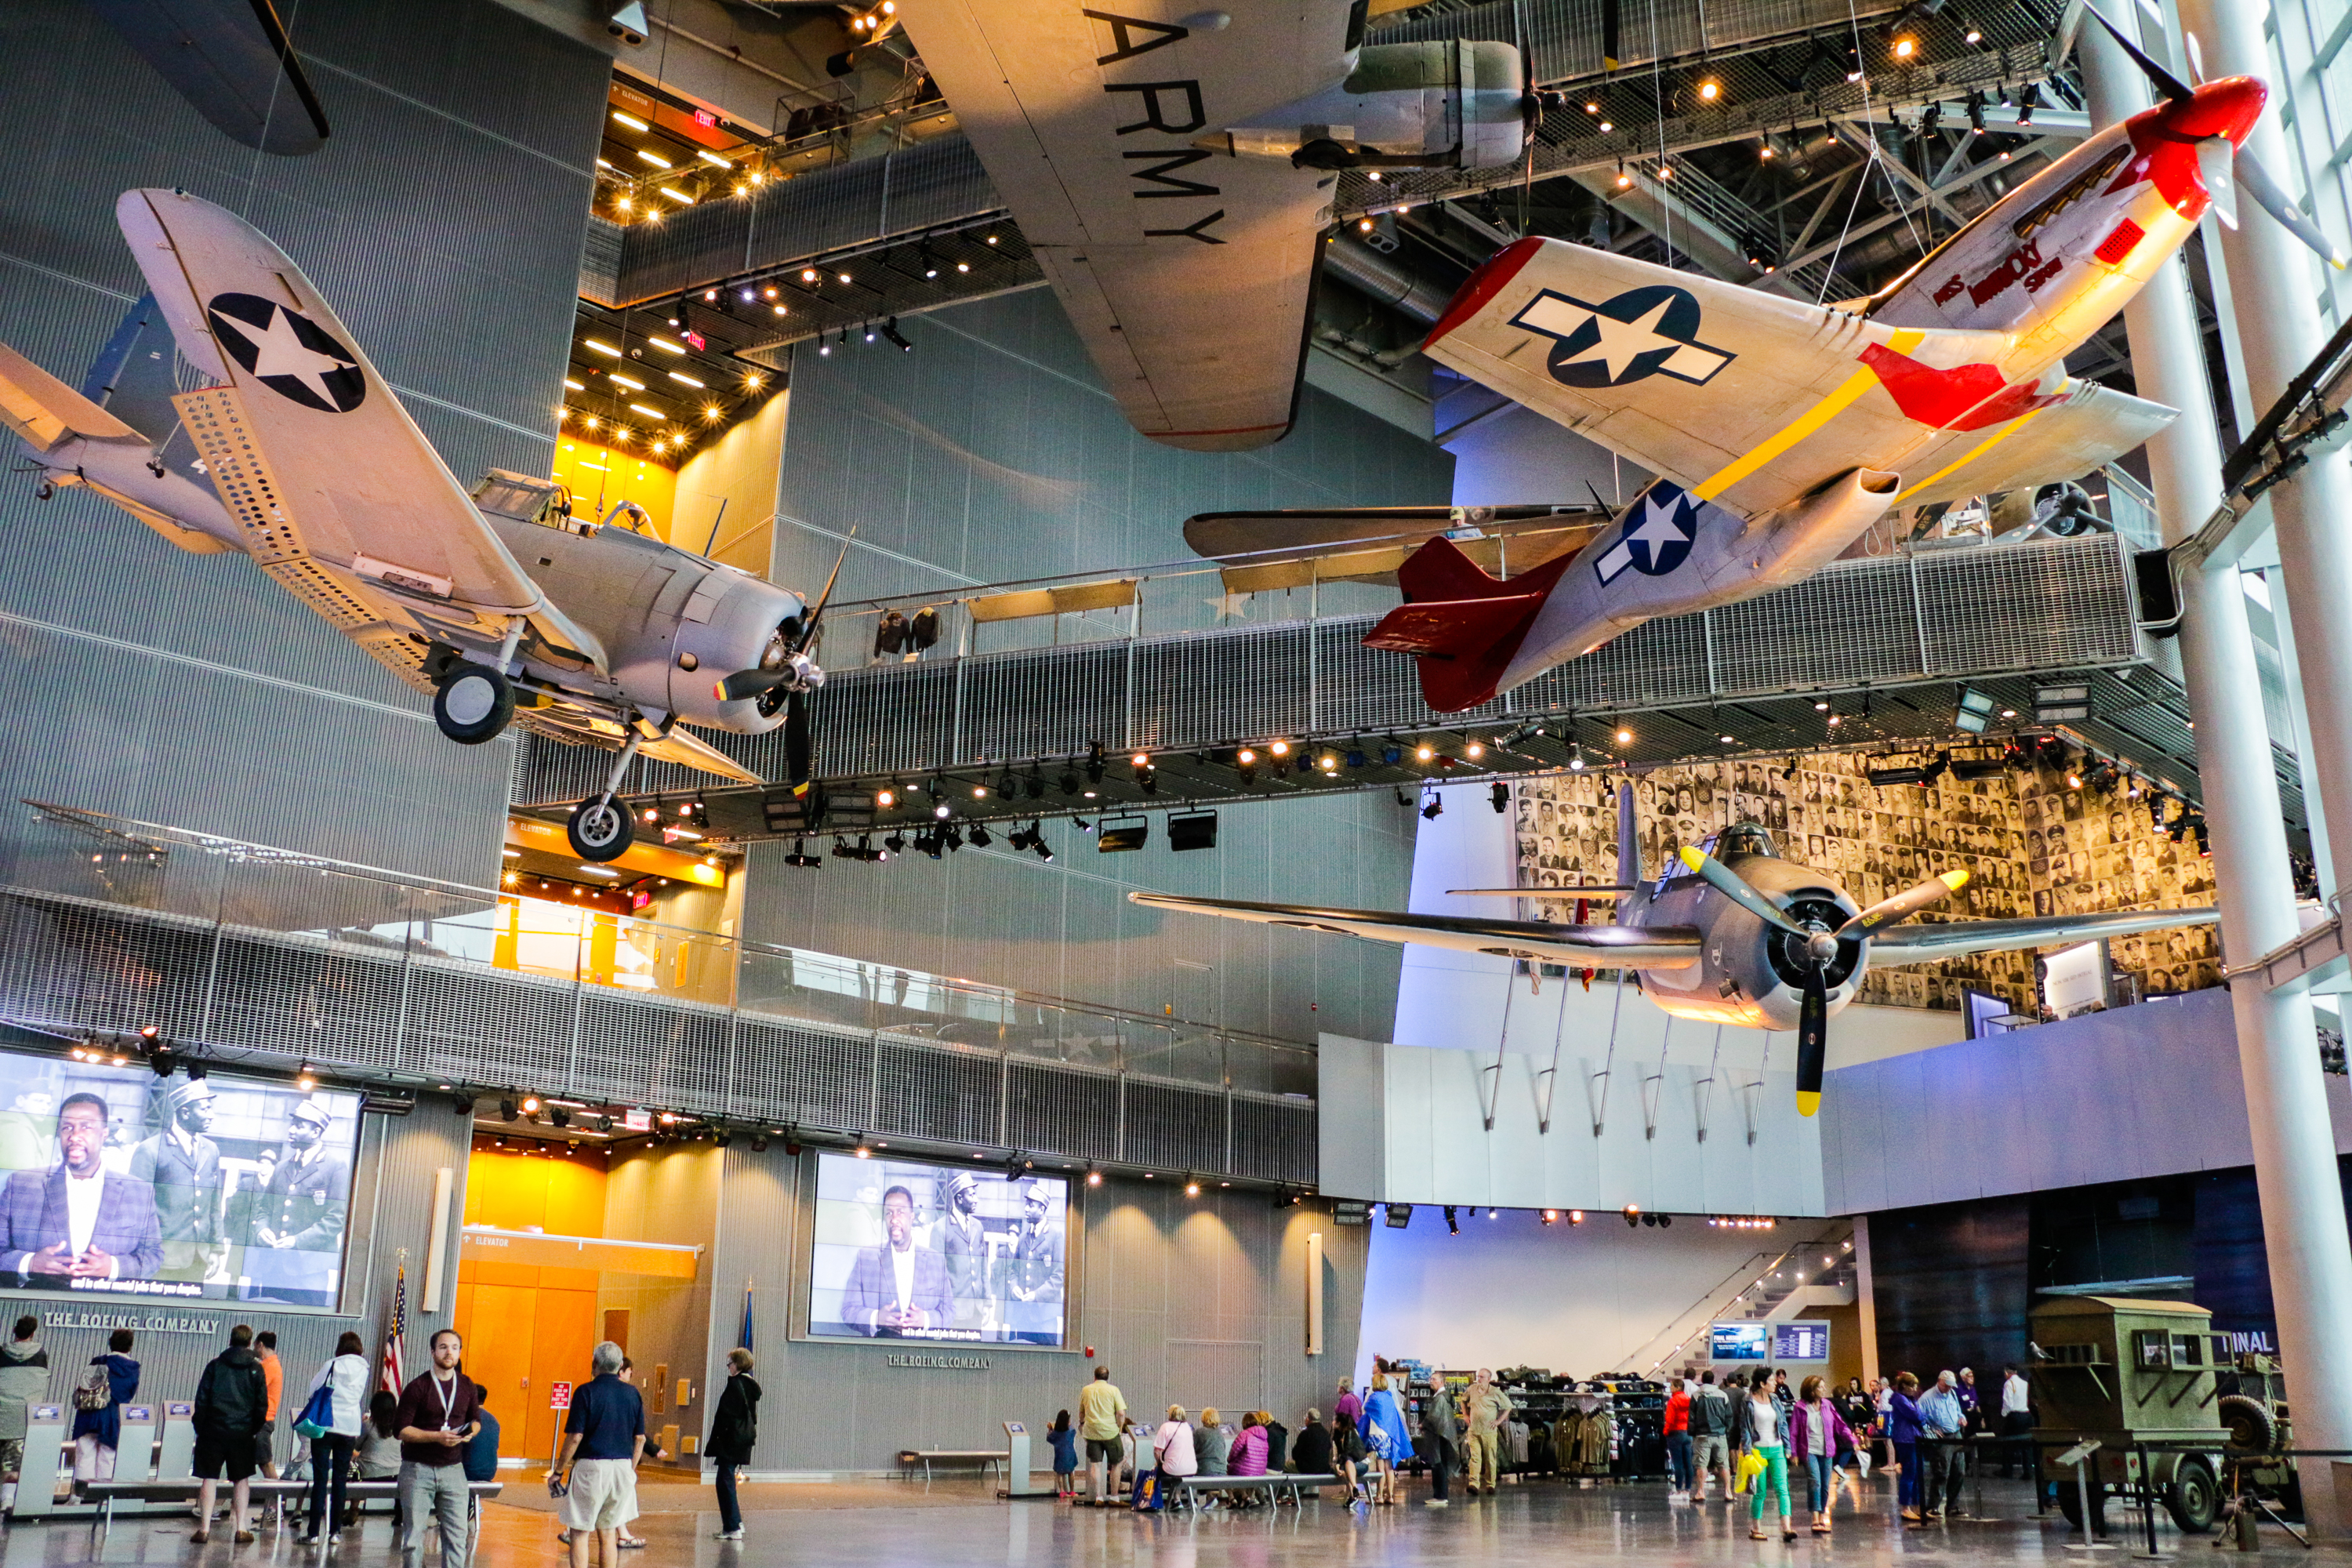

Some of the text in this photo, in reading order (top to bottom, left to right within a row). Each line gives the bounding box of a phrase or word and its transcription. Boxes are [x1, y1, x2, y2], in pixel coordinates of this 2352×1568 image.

[622, 90, 648, 107] ELEVATOR
[1083, 9, 1227, 244] ARMY
[520, 822, 552, 837] ELEVATOR
[475, 1236, 509, 1247] ELEVATOR
[44, 1312, 220, 1334] THE BOEING COMPANY
[2222, 1331, 2273, 1352] INAL
[887, 1354, 993, 1370] THE BOEING COMPANY
